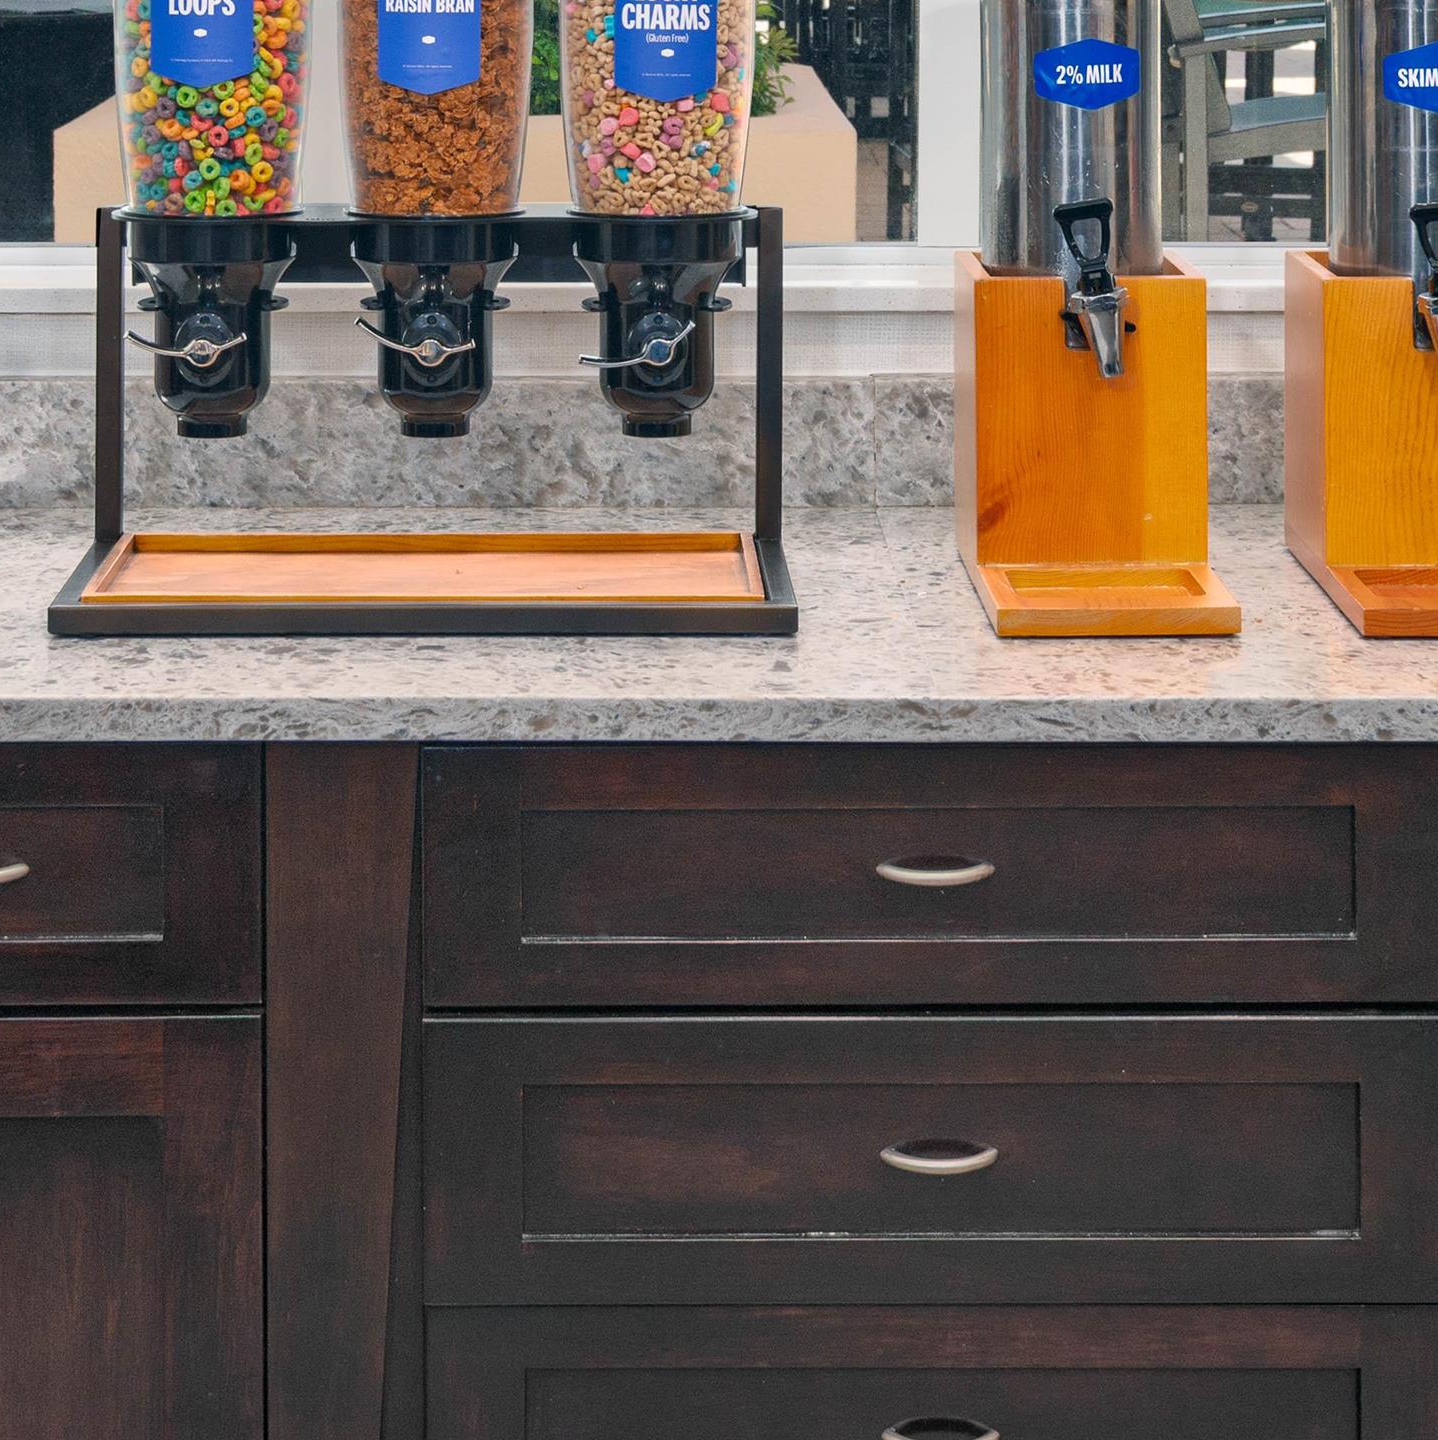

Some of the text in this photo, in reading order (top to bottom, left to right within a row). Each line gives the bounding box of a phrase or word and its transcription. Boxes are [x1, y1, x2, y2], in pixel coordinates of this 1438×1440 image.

[622, 3, 711, 31] CHARMS
[1056, 64, 1123, 85] 2% MILK
